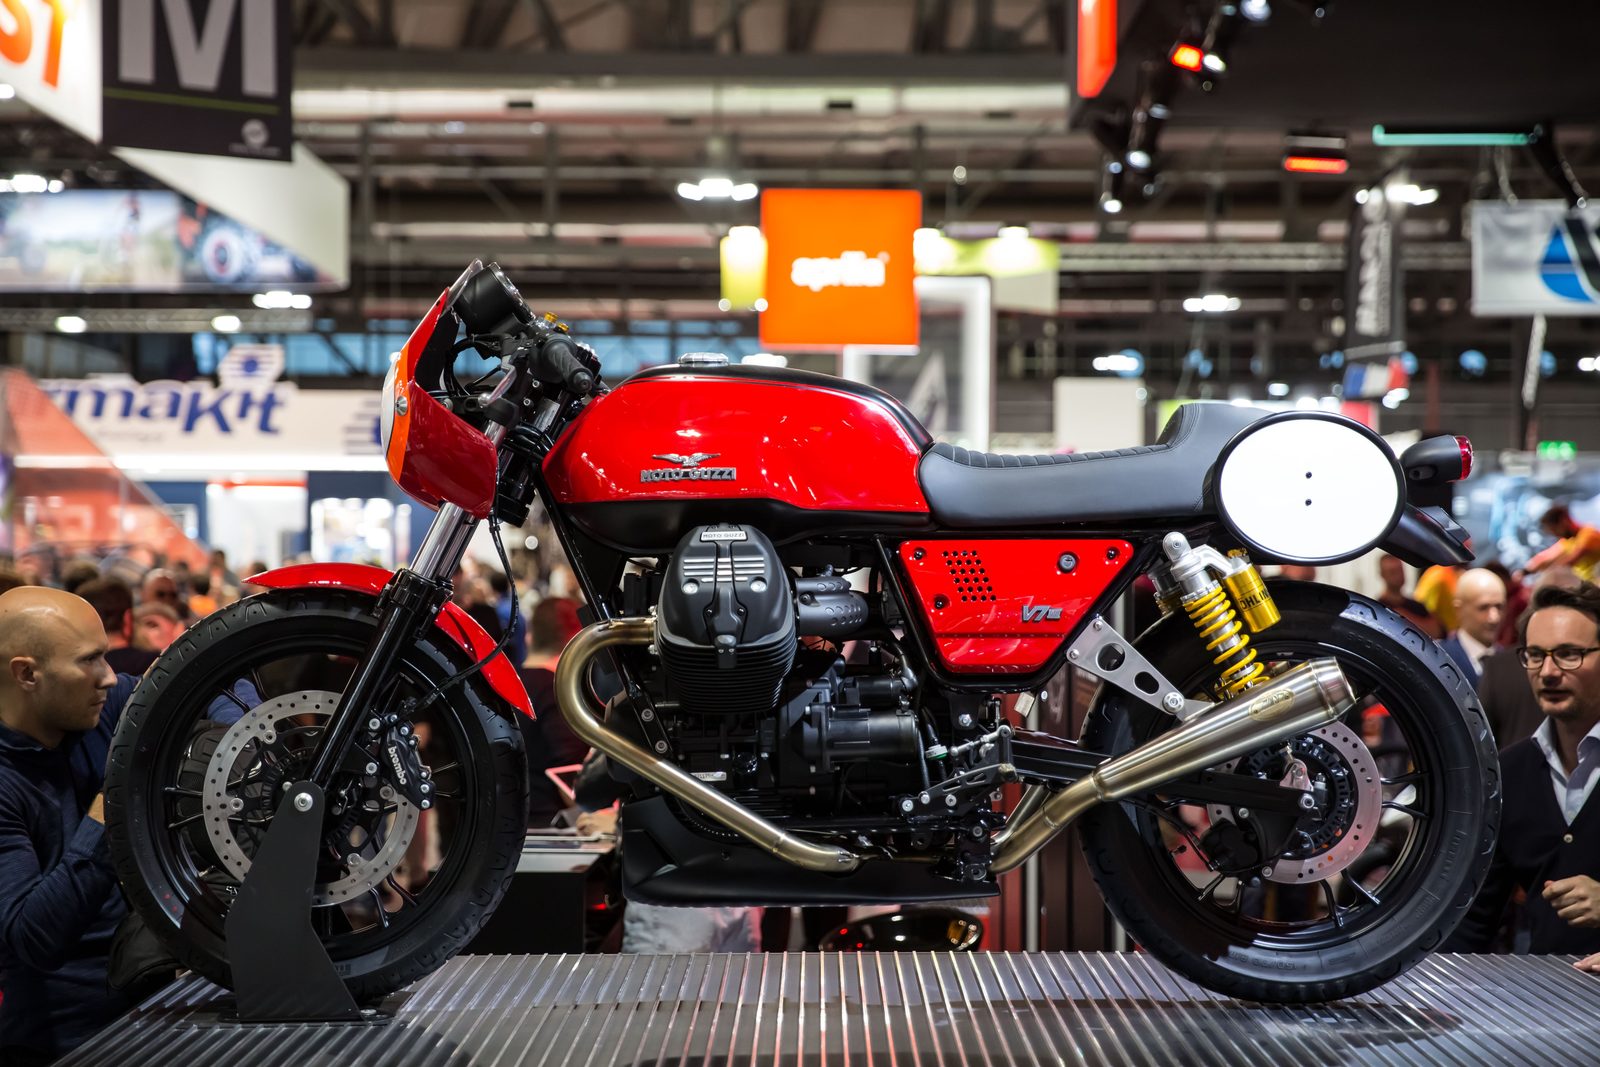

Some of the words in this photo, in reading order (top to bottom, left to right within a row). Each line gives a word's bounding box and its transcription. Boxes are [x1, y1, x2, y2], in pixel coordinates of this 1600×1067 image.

[640, 468, 681, 482] MOTO
[688, 467, 736, 481] GUZZI
[388, 745, 407, 786] brembo
